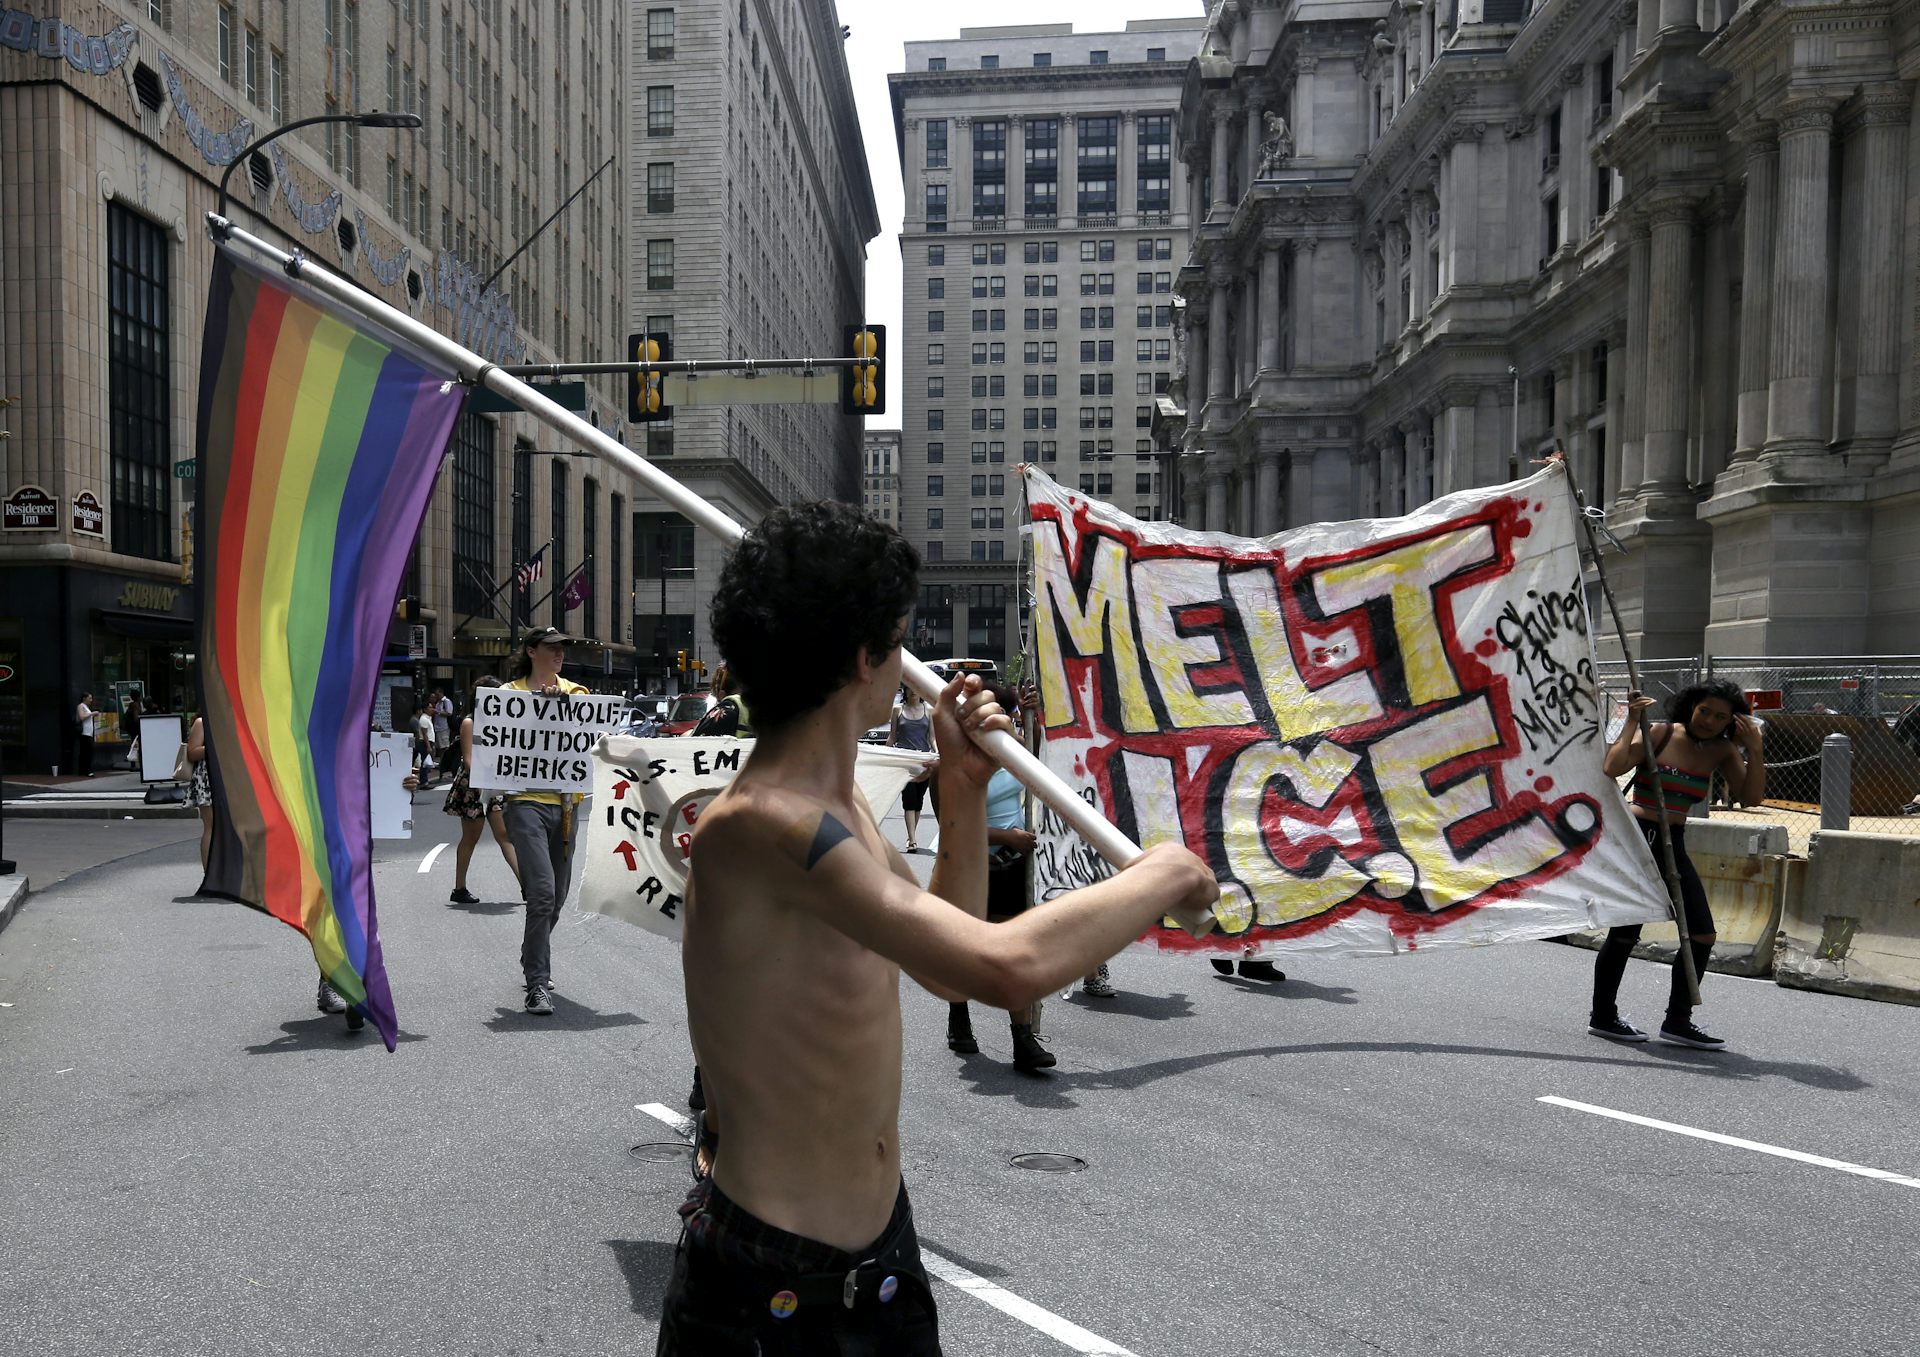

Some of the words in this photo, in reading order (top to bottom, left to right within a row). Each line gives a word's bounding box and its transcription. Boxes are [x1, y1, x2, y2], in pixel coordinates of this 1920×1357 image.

[178, 464, 196, 478] CO
[5, 502, 54, 516] Residence
[22, 514, 39, 526] Inn
[74, 504, 102, 521] Residence
[83, 516, 94, 530] Inn
[119, 582, 179, 611] SUBWAY
[1032, 516, 1503, 742] MELT
[480, 725, 602, 753] SHUTDO
[496, 754, 588, 782] BERKS
[607, 805, 660, 839] ICE
